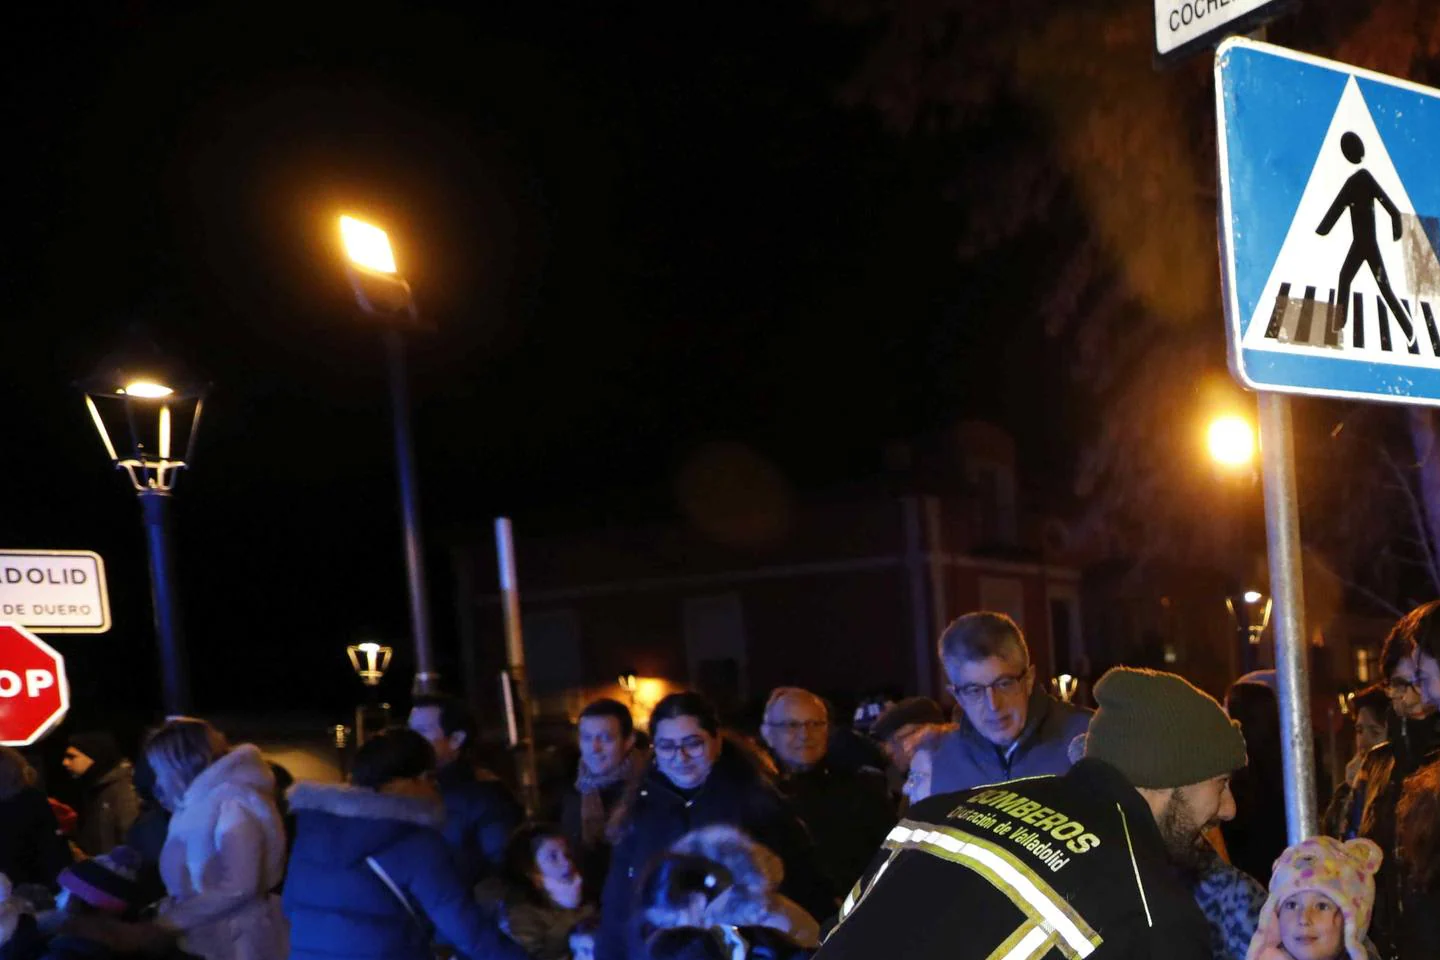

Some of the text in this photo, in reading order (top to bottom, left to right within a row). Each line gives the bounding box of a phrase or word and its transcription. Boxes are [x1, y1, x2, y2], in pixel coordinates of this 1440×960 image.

[0, 568, 87, 585] DOLID
[3, 604, 91, 616] DE DUERO
[967, 790, 1101, 854] BOMBEROS
[993, 821, 1012, 836] de
[1009, 826, 1070, 873] Valladolid
